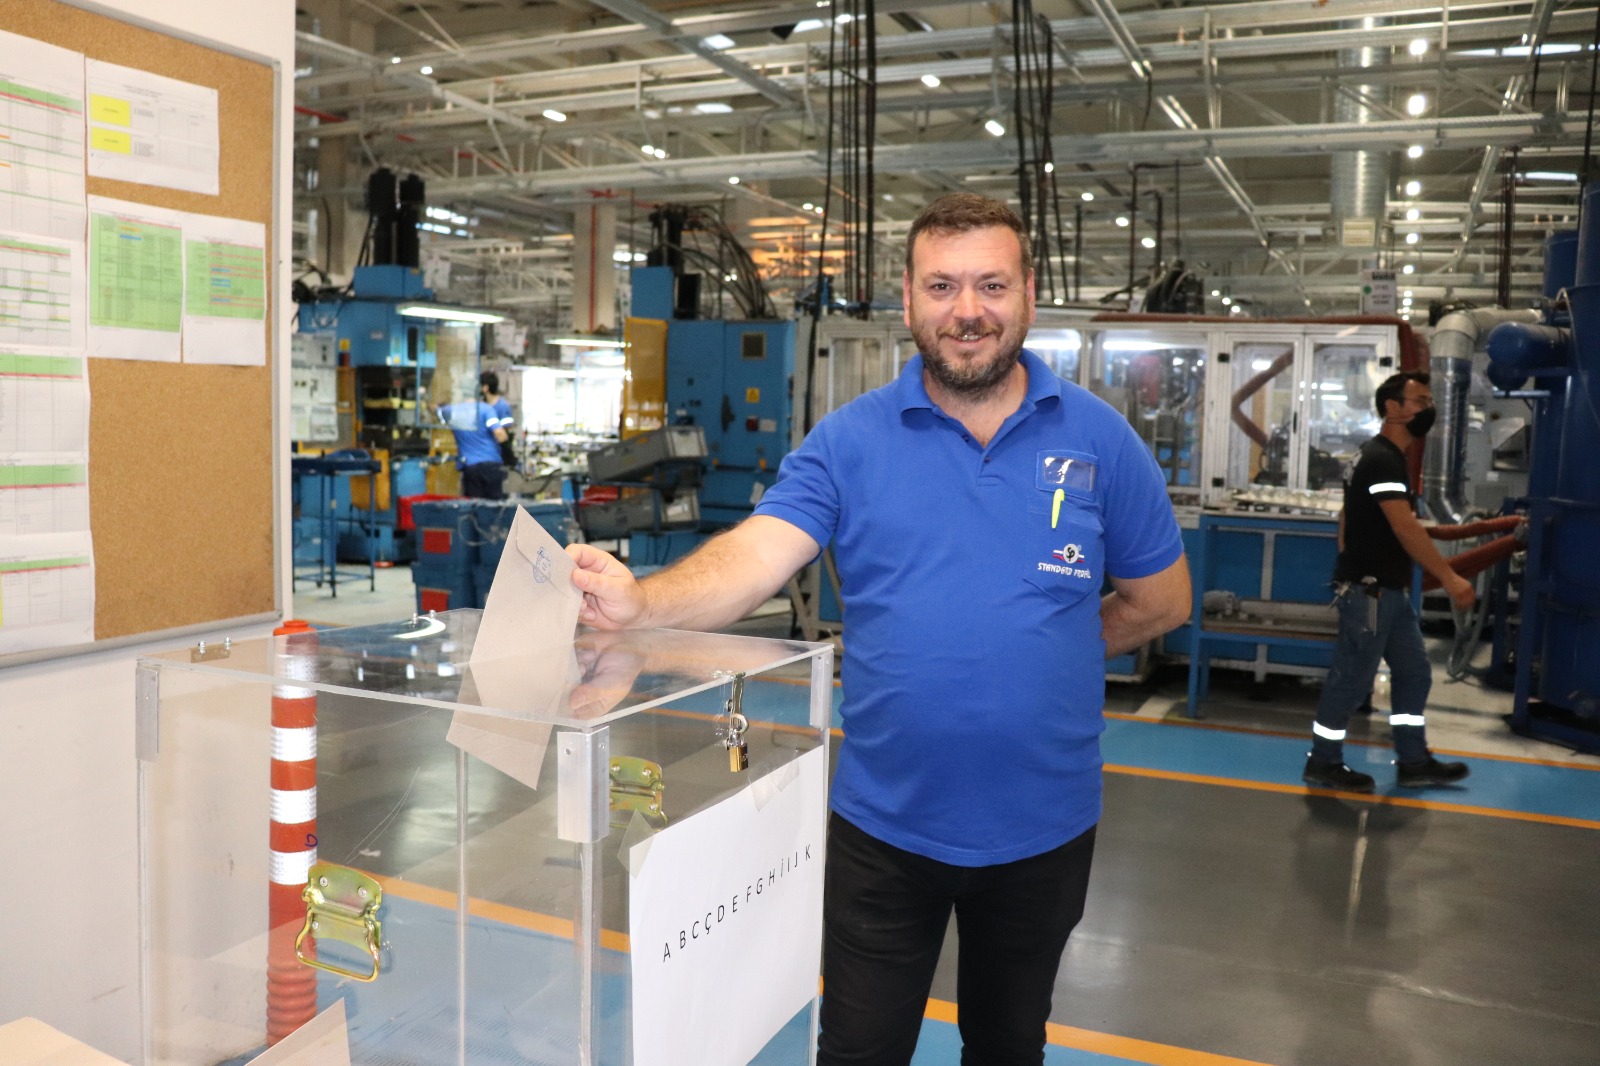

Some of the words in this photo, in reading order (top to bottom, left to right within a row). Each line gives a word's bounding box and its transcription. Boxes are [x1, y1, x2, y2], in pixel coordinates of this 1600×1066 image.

[662, 942, 672, 963] A
[679, 930, 687, 950] B
[691, 920, 700, 939] C
[704, 912, 712, 935] Ç
[717, 904, 725, 923] D
[732, 894, 738, 913] E
[756, 877, 763, 895] G
[768, 868, 776, 886] H
[805, 843, 811, 861] K
